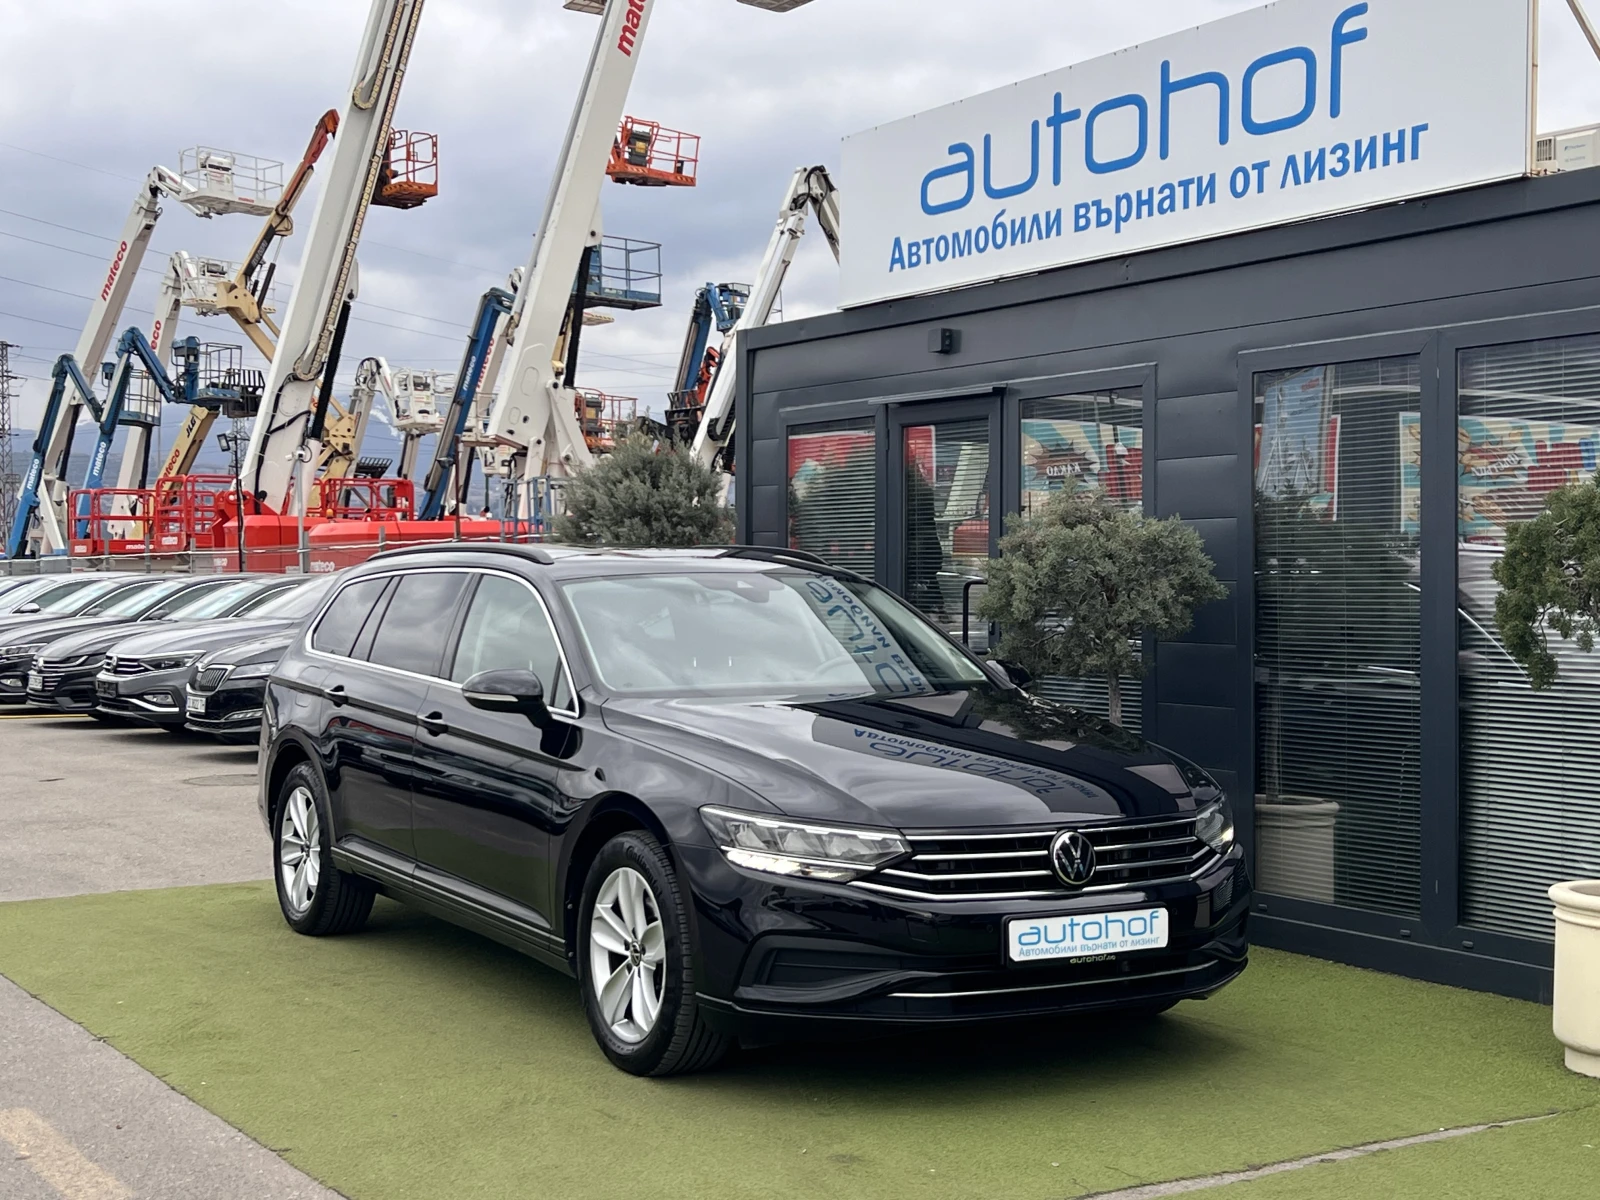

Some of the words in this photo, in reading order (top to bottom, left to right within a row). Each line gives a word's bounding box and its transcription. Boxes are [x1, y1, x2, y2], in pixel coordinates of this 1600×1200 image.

[617, 0, 647, 58] mat
[920, 2, 1369, 215] autohof
[890, 208, 1063, 271] Автомобили
[1073, 172, 1217, 234] върнати
[1228, 159, 1271, 199] от
[1279, 122, 1429, 189] лизинг
[101, 240, 128, 302] mateco
[150, 320, 162, 350] eco
[462, 355, 477, 391] mateco
[185, 415, 197, 438] JLG
[26, 458, 40, 490] mateco
[93, 441, 107, 476] mateco
[1018, 910, 1159, 946] autohof
[1018, 944, 1078, 958] Автомобили
[1080, 941, 1117, 953] върнати
[1119, 940, 1129, 948] от
[1130, 936, 1160, 947] лизинг
